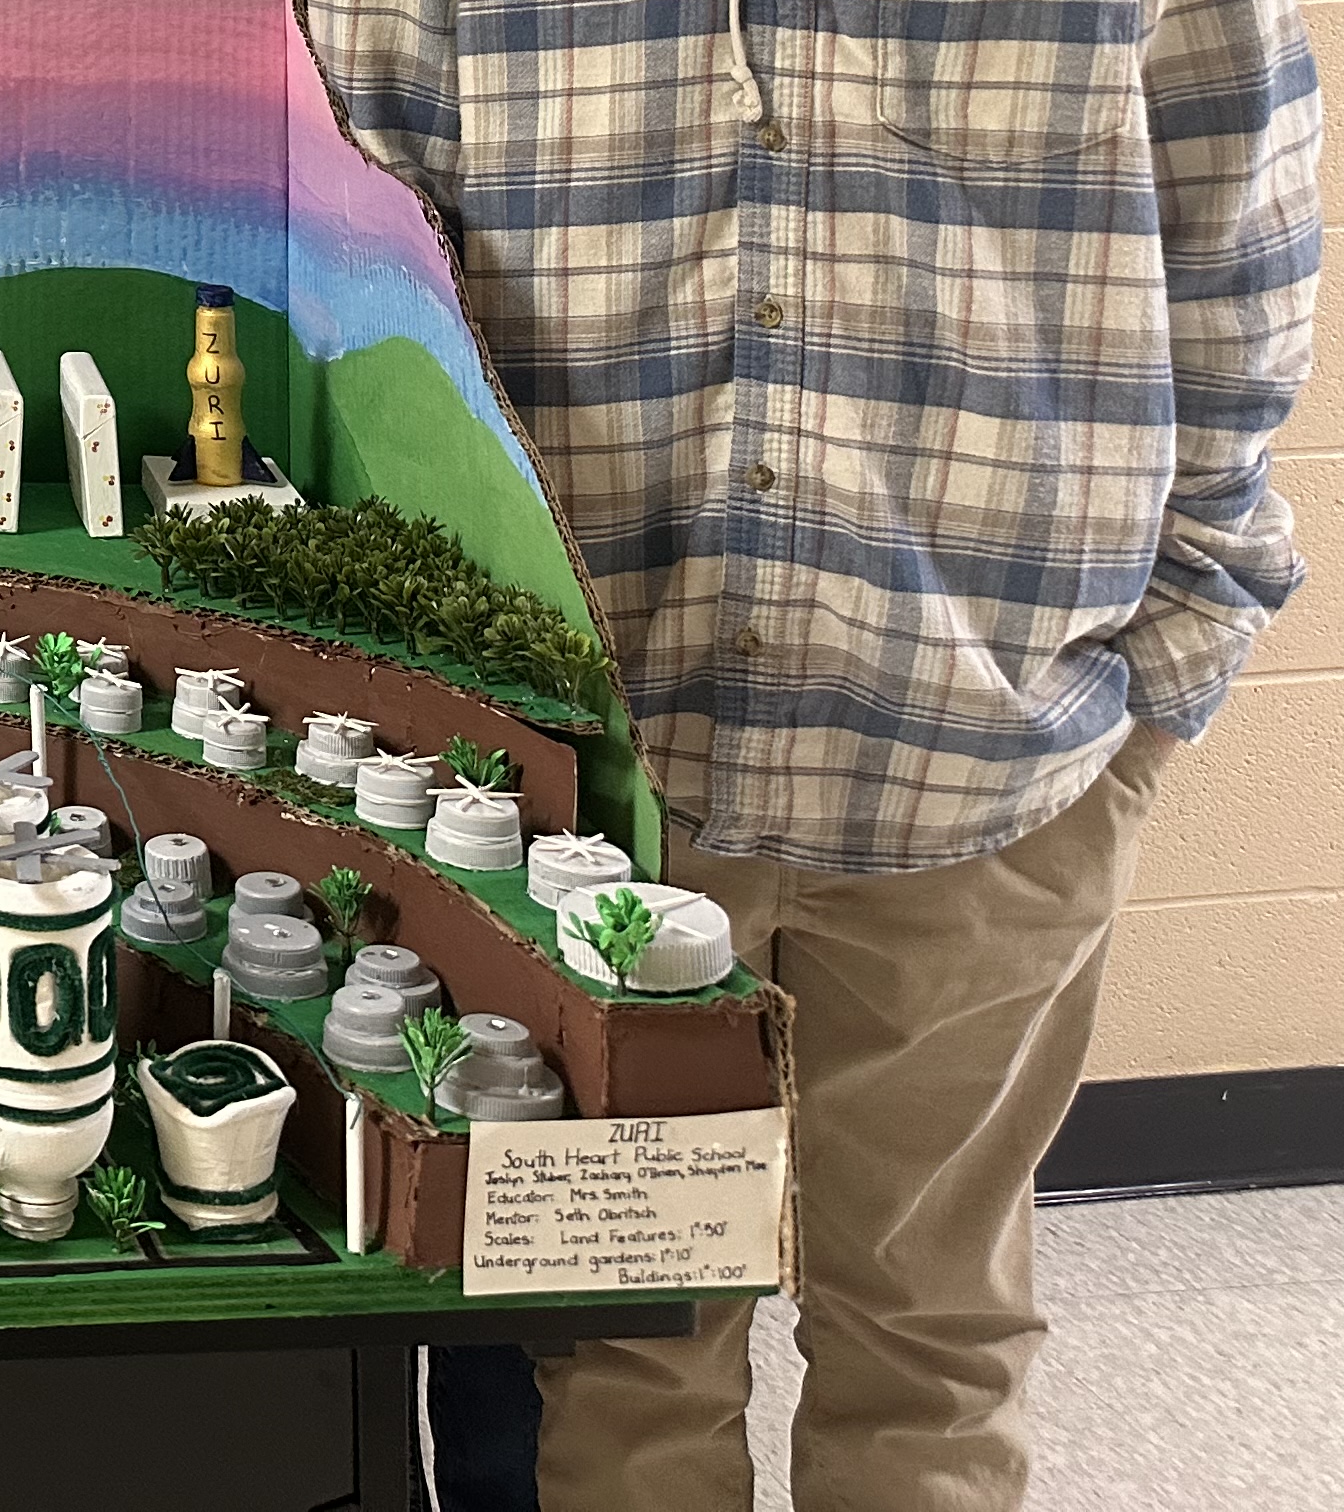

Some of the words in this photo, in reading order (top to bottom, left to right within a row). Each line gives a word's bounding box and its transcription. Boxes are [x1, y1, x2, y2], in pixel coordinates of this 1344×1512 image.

[202, 332, 227, 441] ZURI
[501, 1148, 555, 1169] South
[565, 1147, 621, 1167] Heart
[634, 1145, 684, 1163] Public
[691, 1146, 746, 1162] School
[487, 1190, 555, 1204] Educator:
[603, 1187, 648, 1201] Smith
[486, 1211, 539, 1225] Mentor:
[554, 1207, 591, 1222] Seth
[484, 1230, 535, 1246] Scales:
[560, 1230, 599, 1245] Land
[609, 1228, 682, 1243] Features:
[473, 1254, 579, 1274] Underground
[588, 1251, 657, 1274] gardens:
